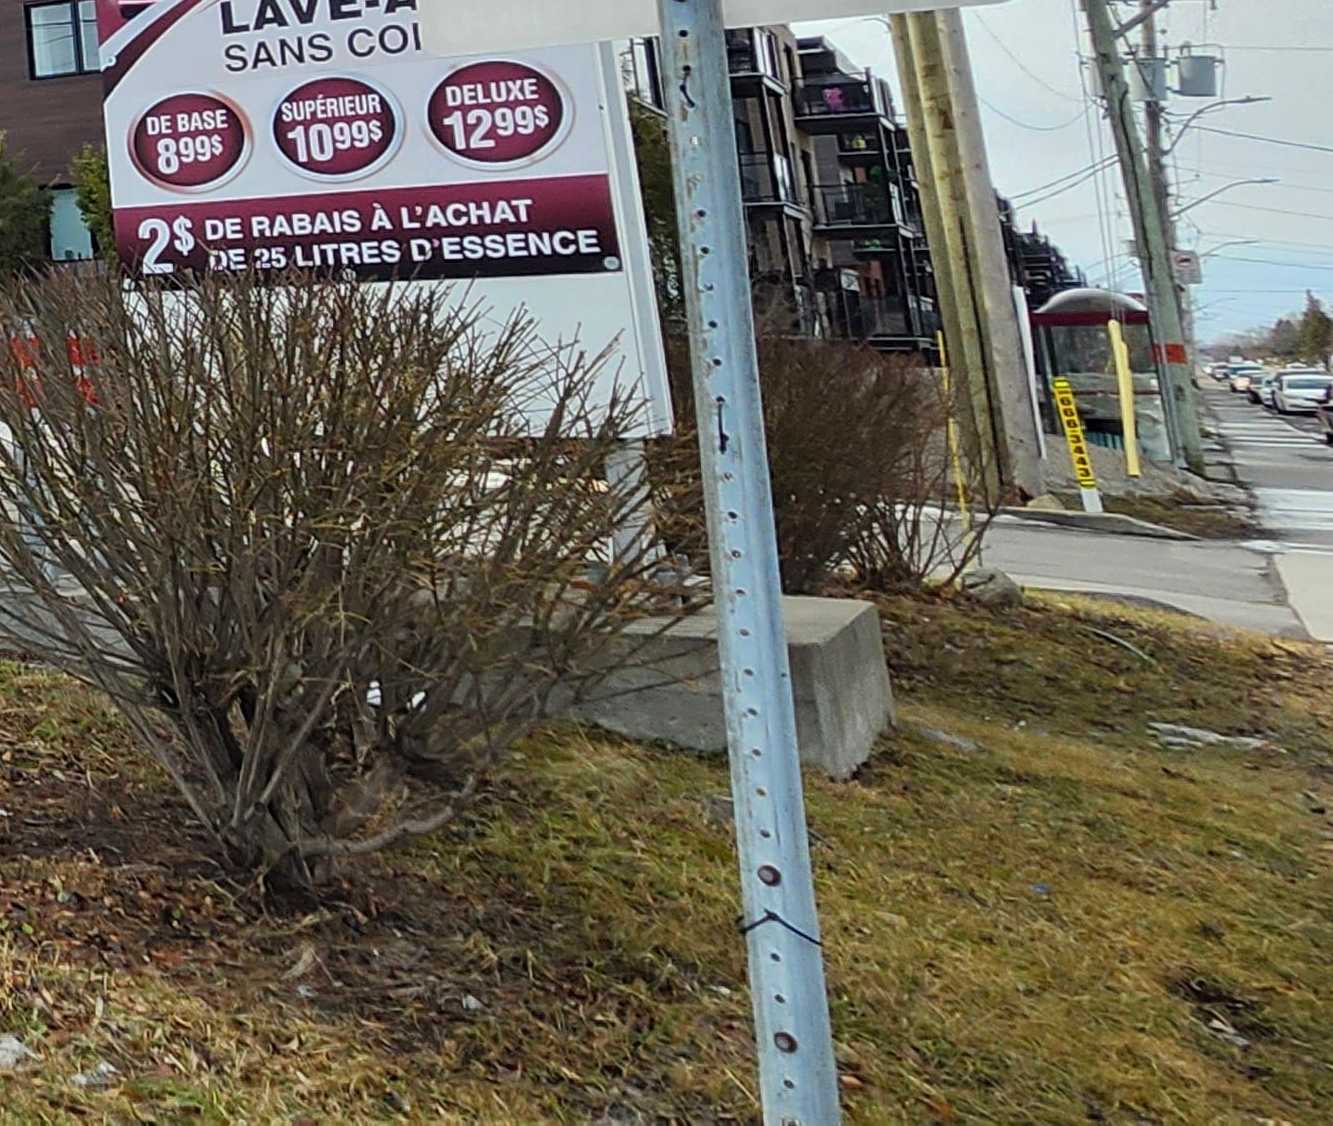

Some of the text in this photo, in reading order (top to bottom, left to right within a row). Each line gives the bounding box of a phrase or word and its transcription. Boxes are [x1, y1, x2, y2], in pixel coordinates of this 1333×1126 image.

[224, 33, 334, 72] SANS
[280, 93, 382, 123] SUPÉRIEUR
[445, 77, 539, 108] DELUXE
[146, 108, 229, 136] DE BASE
[205, 198, 532, 241] DE RABAIS À L'ACHAT
[209, 229, 602, 271] DE 25 LITRES D'ESSENCE
